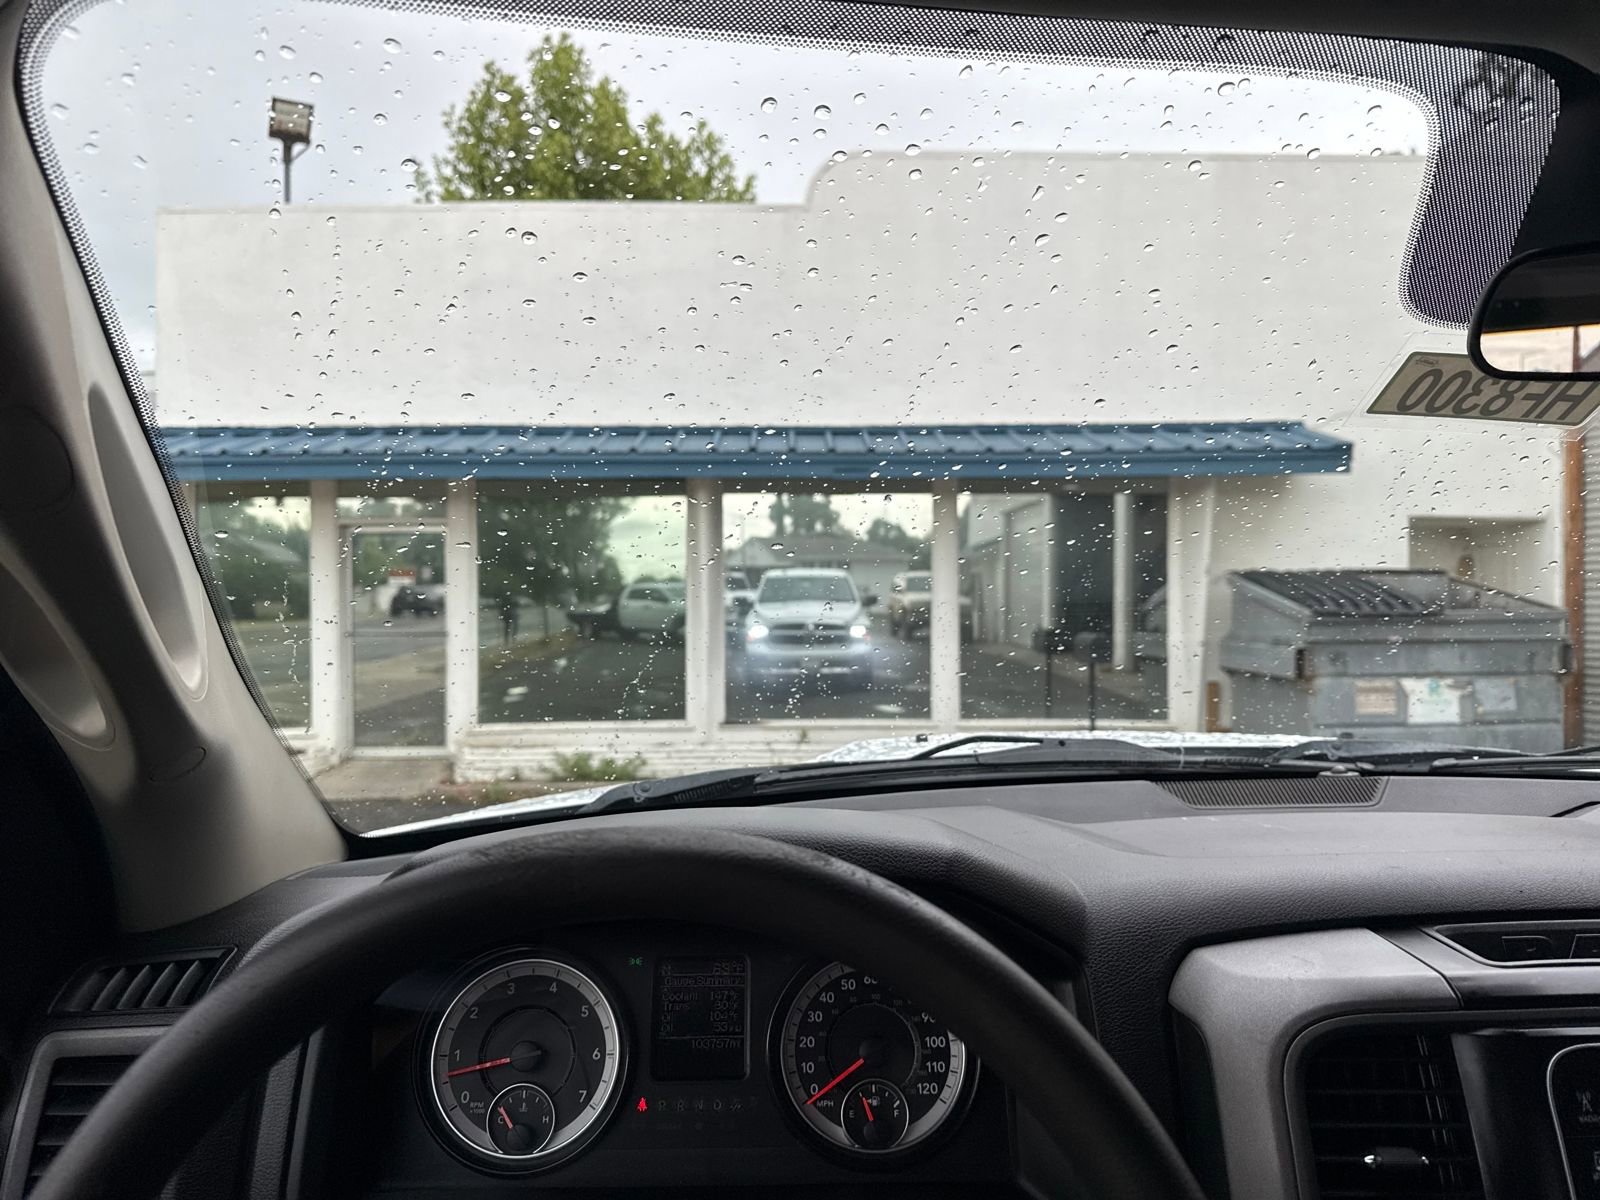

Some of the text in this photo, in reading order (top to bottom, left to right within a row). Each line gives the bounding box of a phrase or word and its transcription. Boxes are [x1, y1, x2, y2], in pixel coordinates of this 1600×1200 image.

[664, 976, 740, 986] Gauge Summary
[840, 979, 856, 991] 50
[507, 983, 515, 994] 3
[549, 983, 558, 993] 4
[819, 991, 835, 1003] 40
[469, 1007, 479, 1019] 2
[581, 1006, 589, 1017] 5
[807, 1011, 823, 1023] 30
[799, 1036, 815, 1048] 20
[925, 1036, 946, 1048] 100
[454, 1050, 460, 1061] 1
[592, 1048, 601, 1060] 6
[801, 1062, 815, 1074] 10
[926, 1061, 945, 1073] 110
[810, 1083, 818, 1095] 0
[917, 1083, 938, 1094] 120
[461, 1091, 470, 1104] 0
[579, 1090, 587, 1102] 7
[469, 1101, 484, 1109] RPM
[542, 1115, 549, 1123] H
[849, 1110, 855, 1118] E
[894, 1109, 900, 1117] F
